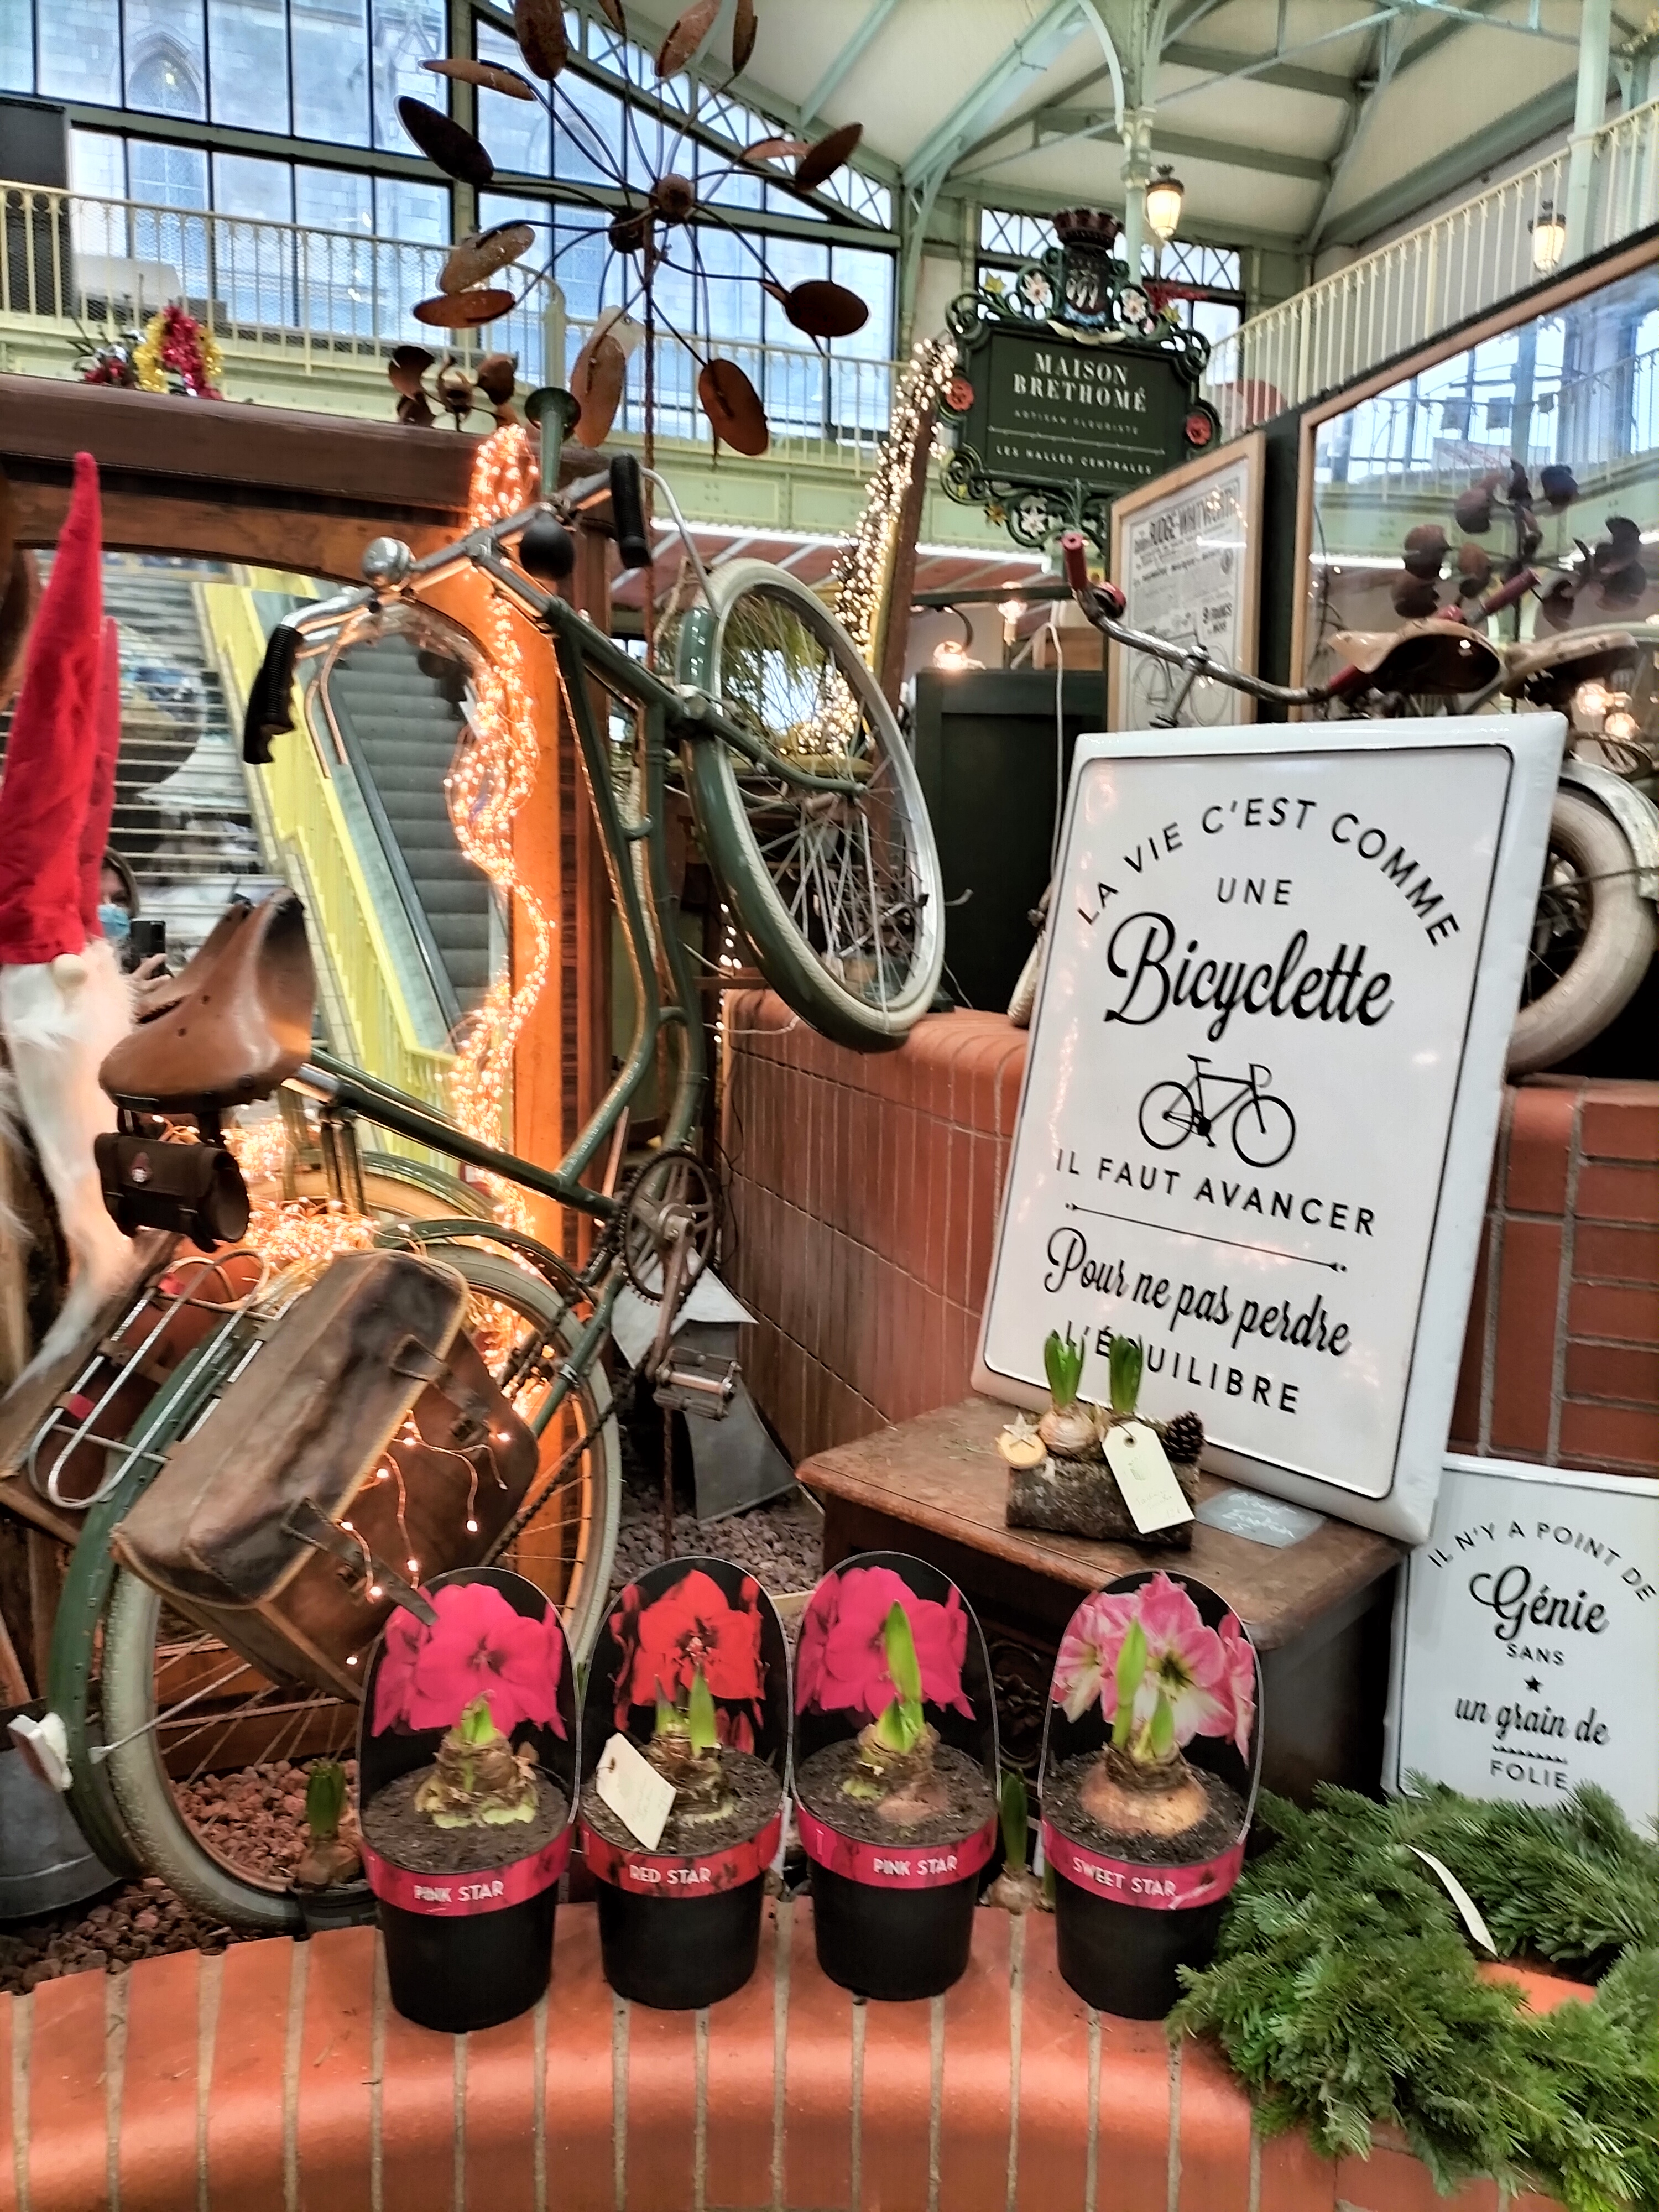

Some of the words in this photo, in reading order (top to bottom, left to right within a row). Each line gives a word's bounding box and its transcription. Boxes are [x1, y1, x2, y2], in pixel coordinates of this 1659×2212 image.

[1035, 353, 1128, 385] MAISON
[996, 446, 1019, 457] LES
[1026, 449, 1073, 465] HALLES
[1081, 457, 1152, 475] CENTRALES
[1077, 881, 1119, 925] LA
[1123, 822, 1183, 873] VIE
[1201, 797, 1317, 833] C'EST
[1331, 813, 1460, 946] COMME
[1217, 877, 1292, 905] UNE
[1103, 911, 1395, 1042] Bicyclette
[1056, 1149, 1080, 1176] IL
[1098, 1158, 1181, 1194] FAUT
[1194, 1177, 1376, 1237] AVANCER
[1045, 1227, 1129, 1293] Pour
[1132, 1271, 1171, 1308] ne
[1169, 1285, 1234, 1332] pas
[1231, 1294, 1352, 1357] perdre
[1065, 1319, 1300, 1414] L'ÉUILIBRE
[1427, 1548, 1453, 1568] IL
[1454, 1522, 1495, 1551] N'Y
[1507, 1521, 1525, 1538] A
[1536, 1521, 1622, 1566] POINT
[1621, 1567, 1657, 1602] DE
[1468, 1564, 1610, 1641] Génie
[1506, 1643, 1564, 1667] SANS
[1454, 1698, 1491, 1724] un
[1495, 1702, 1570, 1740] grain
[1574, 1707, 1611, 1746] de
[1490, 1759, 1569, 1790] FOLIE
[629, 1864, 661, 1884] RED
[666, 1867, 711, 1884] STAR
[873, 1858, 911, 1876] PINK
[916, 1854, 958, 1876] STAR
[1072, 1856, 1125, 1890] SWEET
[1131, 1877, 1177, 1896] STAR
[414, 1885, 452, 1902] PINK
[457, 1880, 504, 1902] STAR
